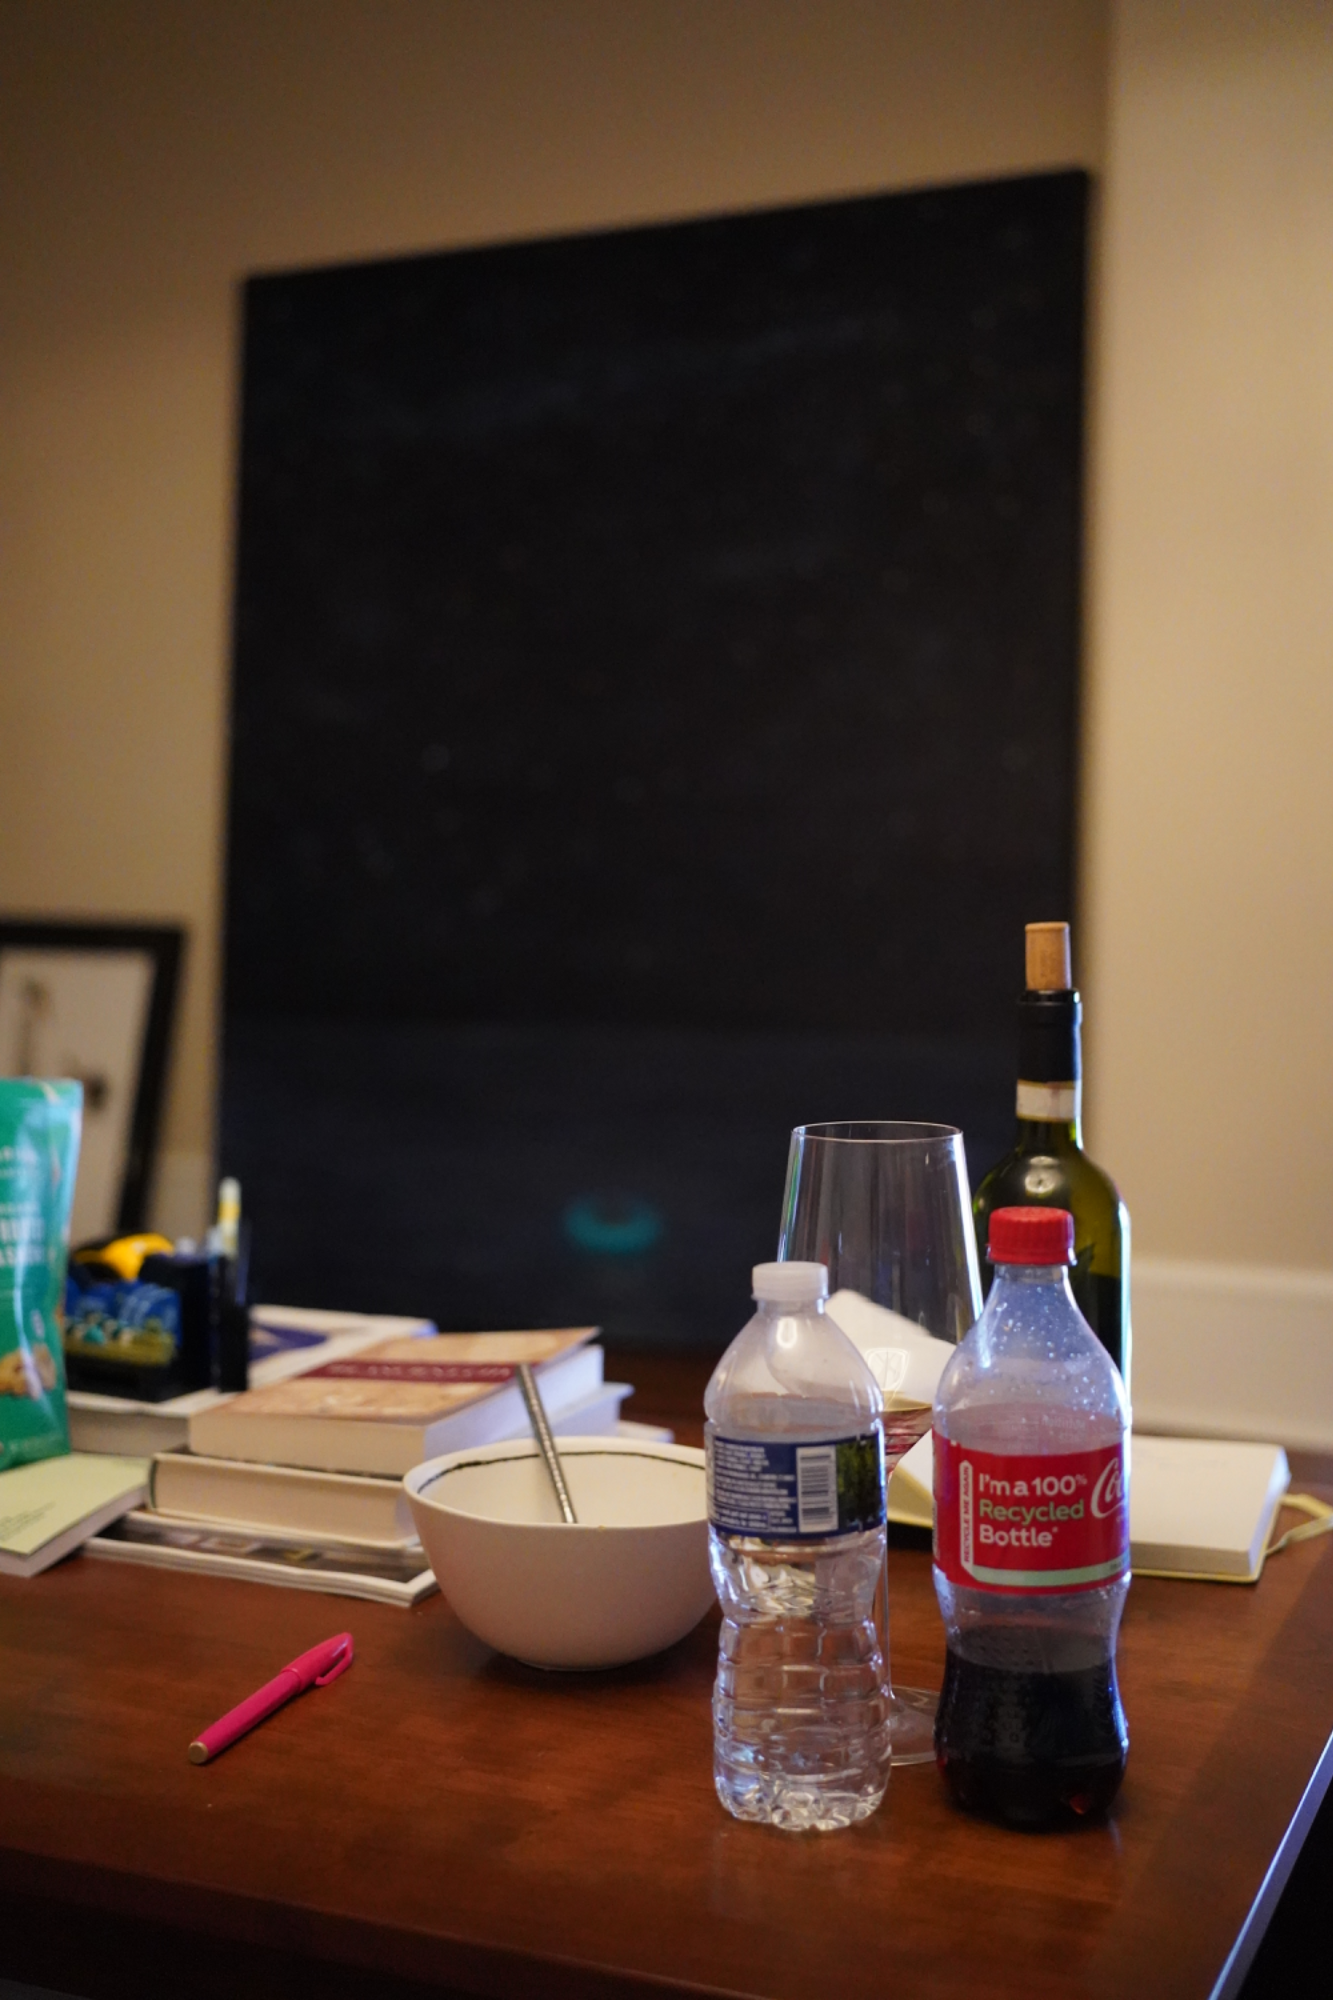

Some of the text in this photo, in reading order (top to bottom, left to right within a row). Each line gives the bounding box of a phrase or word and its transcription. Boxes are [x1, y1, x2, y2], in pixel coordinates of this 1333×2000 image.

[979, 1473, 1087, 1496] I'm a 100%
[963, 1499, 970, 1515] ME
[979, 1498, 1085, 1526] Recycled
[963, 1518, 971, 1563] RECYCLE
